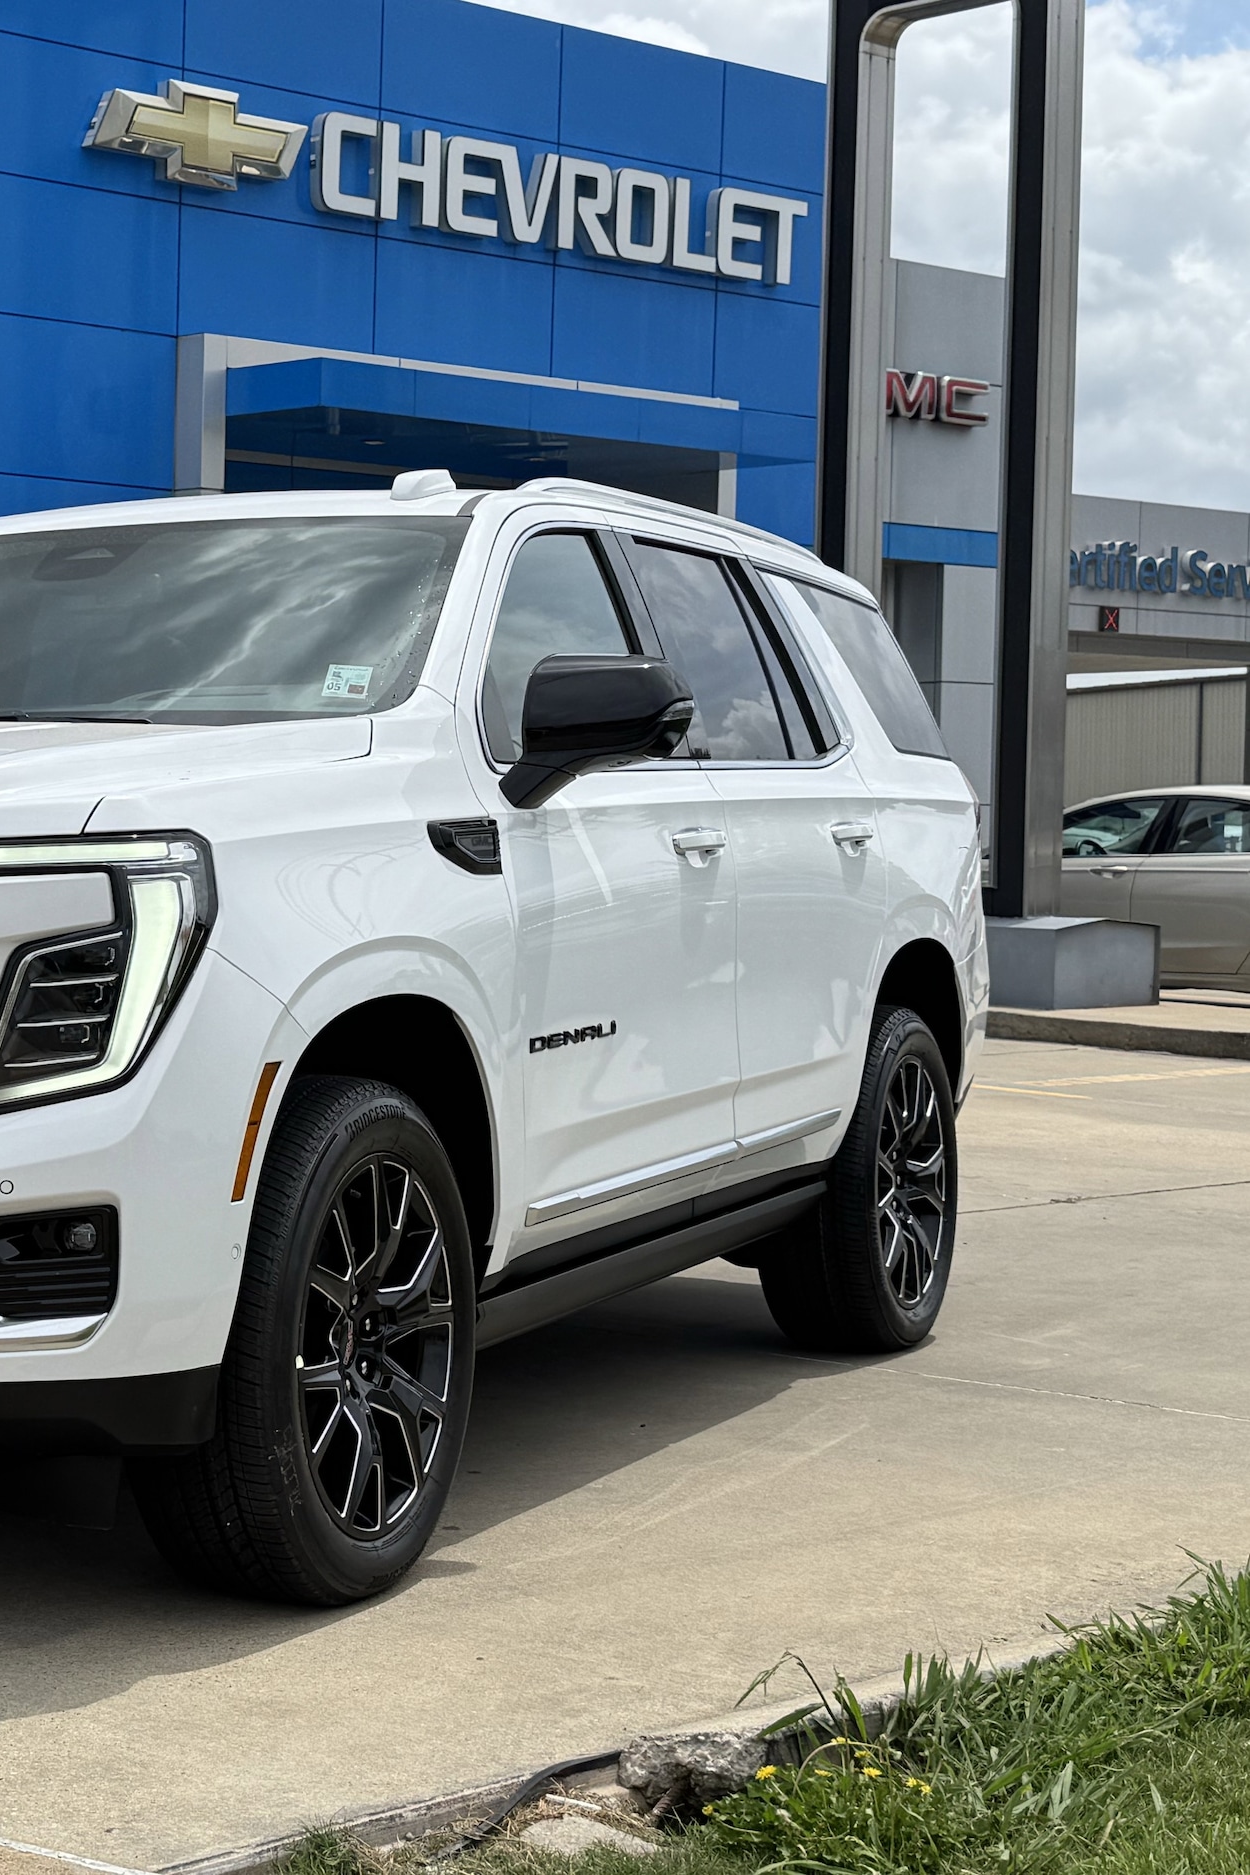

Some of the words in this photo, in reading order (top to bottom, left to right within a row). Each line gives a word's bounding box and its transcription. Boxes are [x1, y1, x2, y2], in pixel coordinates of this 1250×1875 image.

[311, 111, 808, 286] CHEVROLET
[886, 368, 990, 427] MC
[529, 1020, 617, 1054] DENALI
[344, 1104, 406, 1143] BRIDGESTONE
